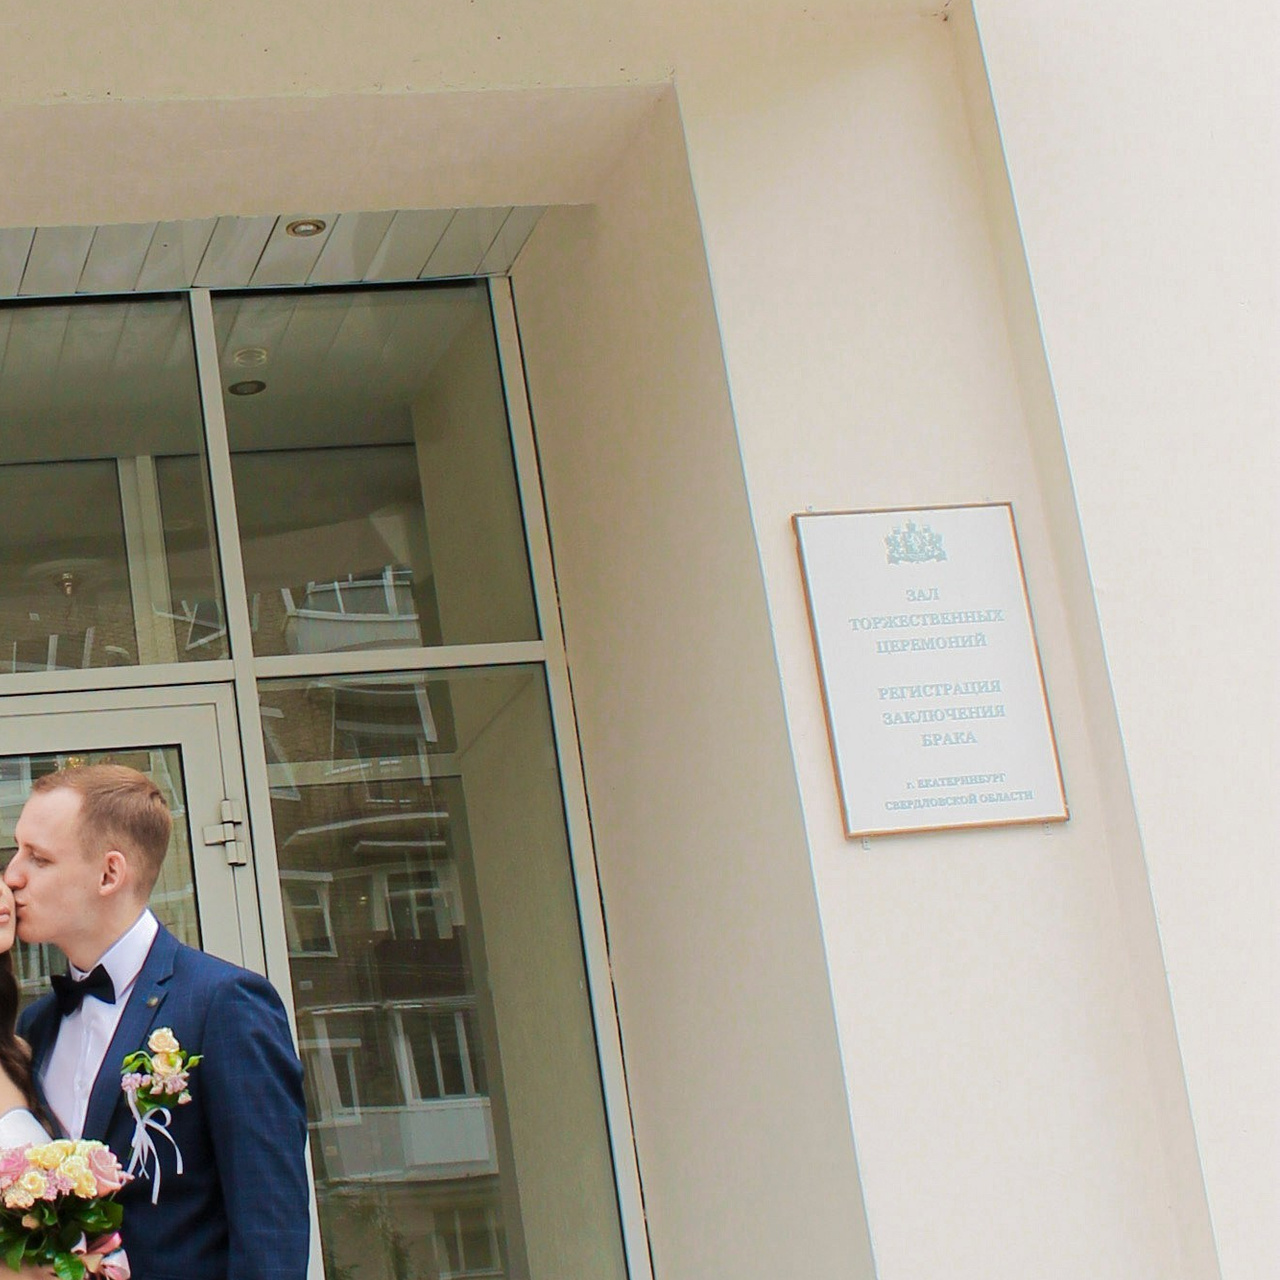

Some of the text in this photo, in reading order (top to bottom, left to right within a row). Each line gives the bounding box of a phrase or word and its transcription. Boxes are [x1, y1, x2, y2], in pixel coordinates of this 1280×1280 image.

[905, 588, 939, 601] ЗАЛ
[849, 609, 1004, 631] ТОРЖЕСТВЕННЫХ
[876, 632, 987, 655] ЦЕРЕМОНИЙ
[878, 680, 1002, 700] РЕГИСТРАЦИЯ
[883, 705, 1005, 725] ЗАКЛЮЧЕНИЯ
[921, 732, 977, 747] БРАКА
[885, 790, 1034, 811] СВЕРДЛОВСКОЙ ОБЛАСТИ
